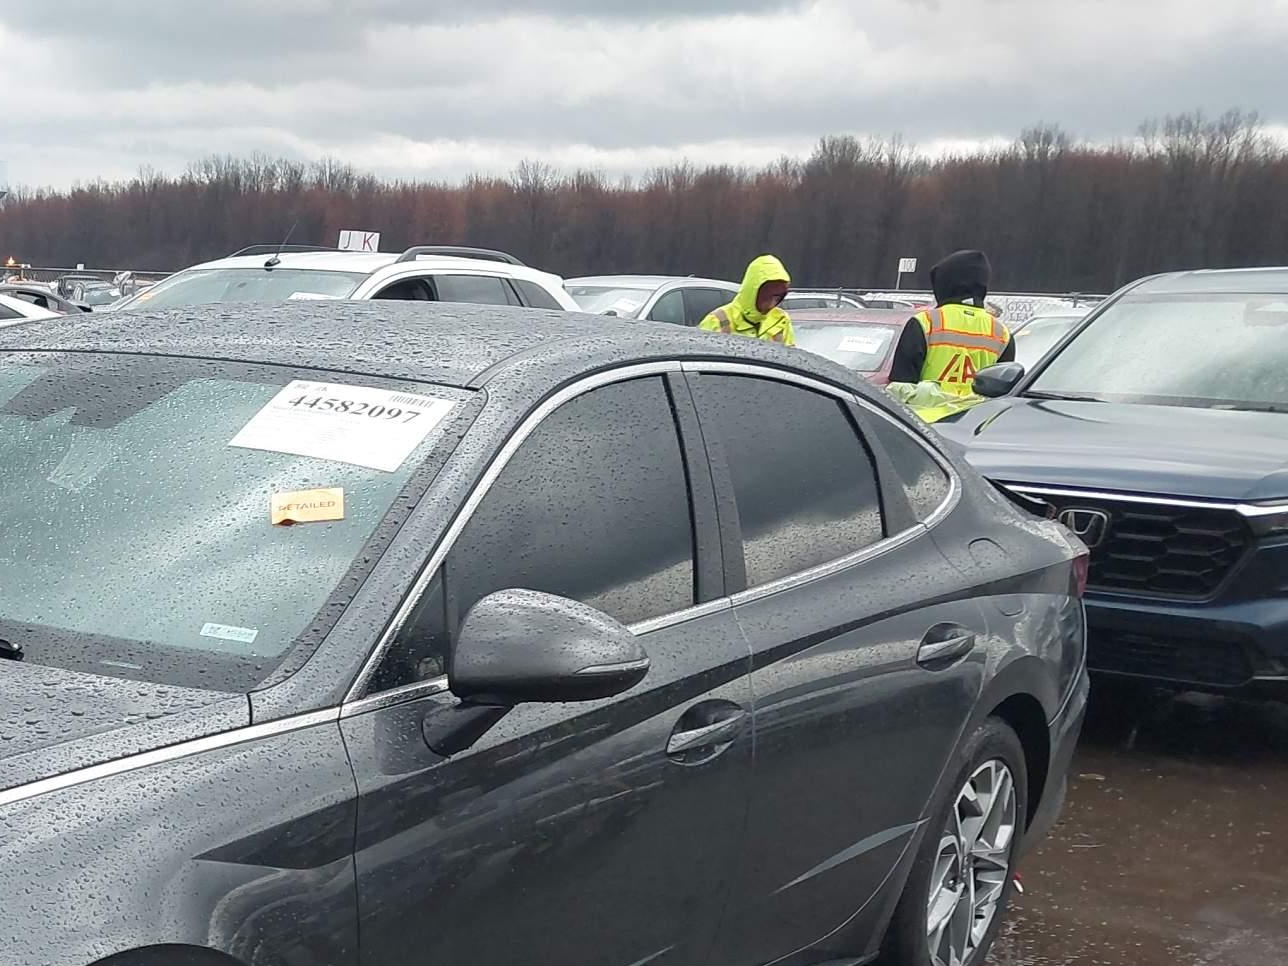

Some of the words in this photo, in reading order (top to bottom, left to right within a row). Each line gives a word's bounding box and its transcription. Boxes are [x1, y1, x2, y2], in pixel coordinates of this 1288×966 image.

[344, 232, 352, 249] J
[362, 233, 375, 251] K
[288, 395, 421, 424] 44582097
[278, 500, 336, 511] DETAILED
